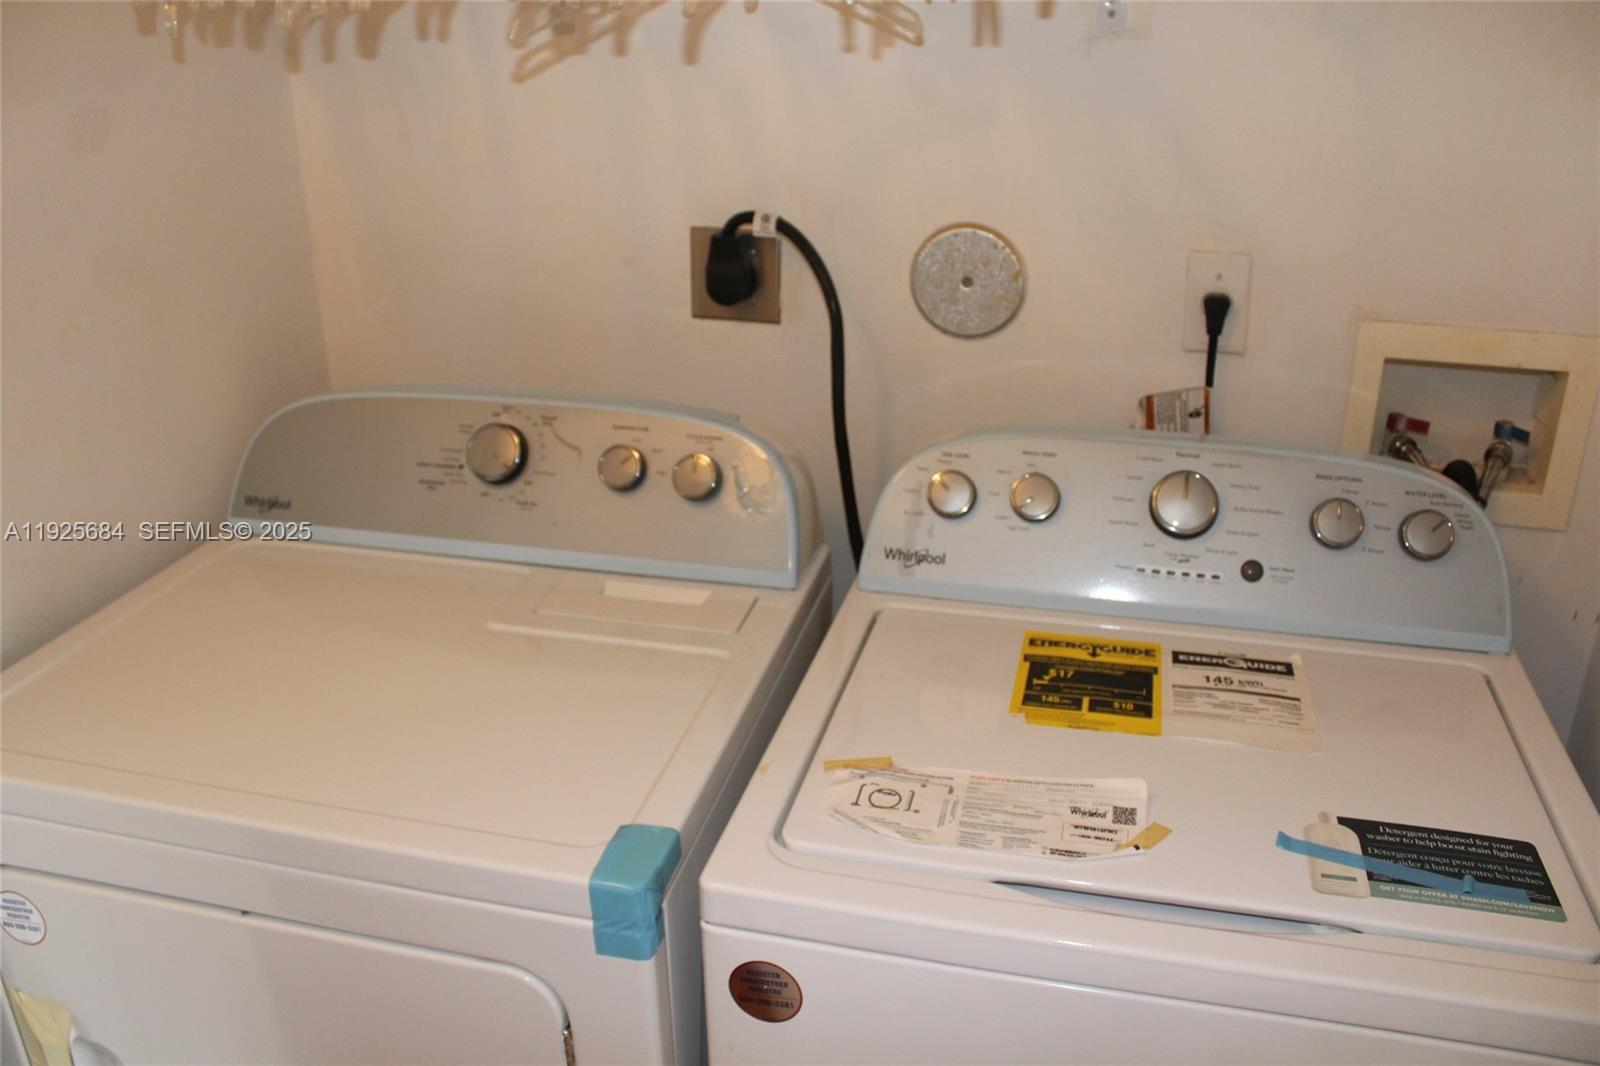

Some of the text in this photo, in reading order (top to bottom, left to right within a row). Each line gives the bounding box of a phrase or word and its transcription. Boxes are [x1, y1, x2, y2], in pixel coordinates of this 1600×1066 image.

[243, 495, 292, 512] Whirlpool
[884, 546, 946, 569] Whirlpool
[1029, 638, 1157, 658] ENERGYGUIDE
[1048, 668, 1075, 678] $17
[1204, 674, 1234, 686] 145
[1069, 805, 1108, 819] Whirlpool
[1366, 833, 1400, 842] washer
[1415, 839, 1436, 849] help
[1438, 841, 1466, 851] boost
[1467, 845, 1491, 854] stain
[1379, 825, 1513, 851] Detergent designed for your
[1451, 858, 1475, 867] pour
[1478, 862, 1503, 872] votre
[1431, 863, 1458, 873] lutter
[1460, 867, 1493, 878] contre
[1495, 871, 1510, 881] les
[1511, 874, 1545, 886] taches
[1379, 884, 1397, 892] GET
[1398, 886, 1420, 895] YOUR
[1421, 889, 1447, 898] OFFER
[1448, 892, 1459, 900] AT
